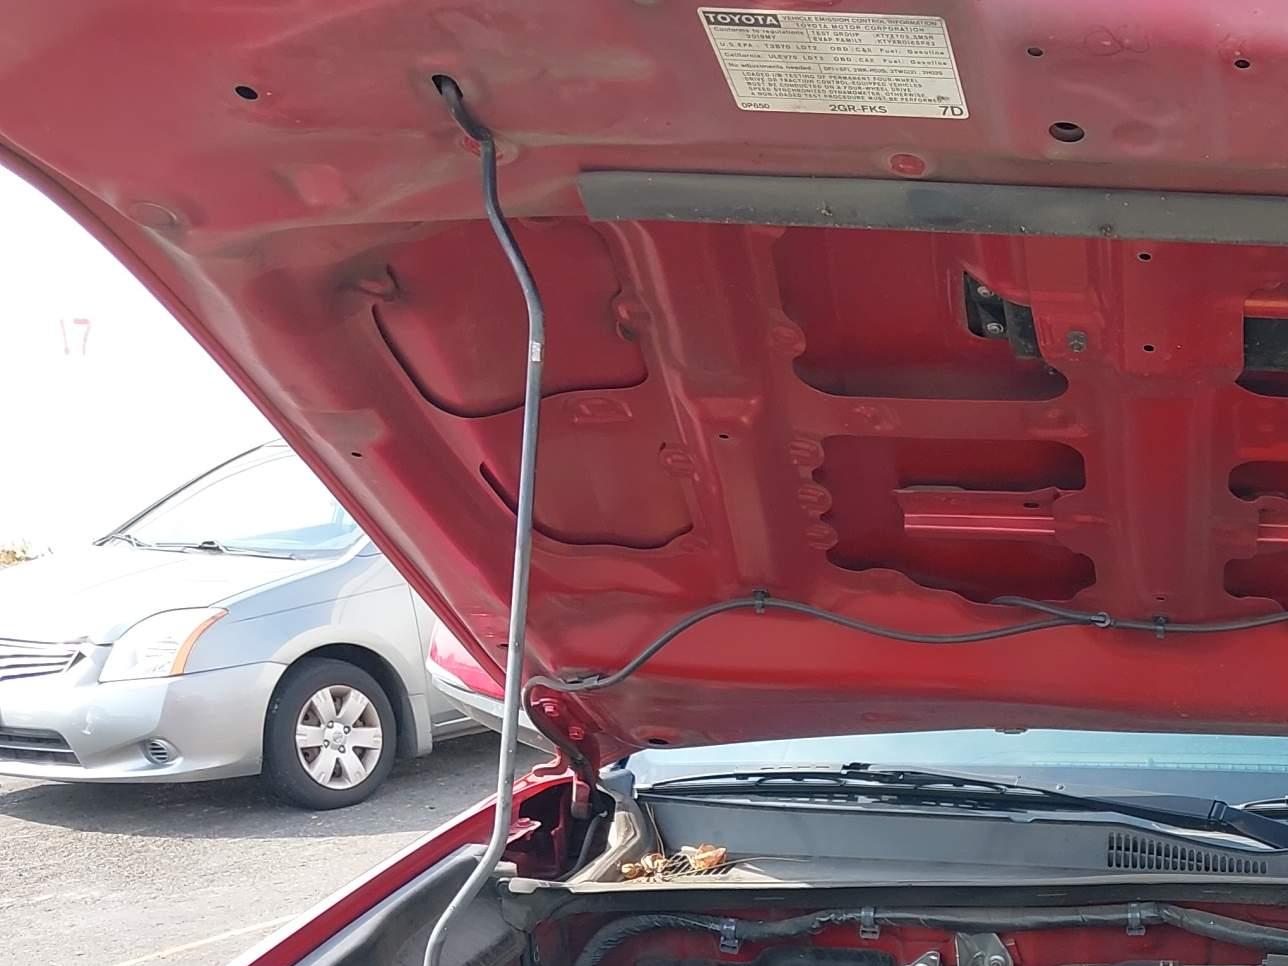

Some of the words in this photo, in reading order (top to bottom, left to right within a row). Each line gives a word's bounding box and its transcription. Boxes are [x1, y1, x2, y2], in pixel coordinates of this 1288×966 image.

[704, 13, 779, 25] TOYOTA
[829, 104, 887, 113] 2GR-FKS
[939, 105, 964, 116] 7D
